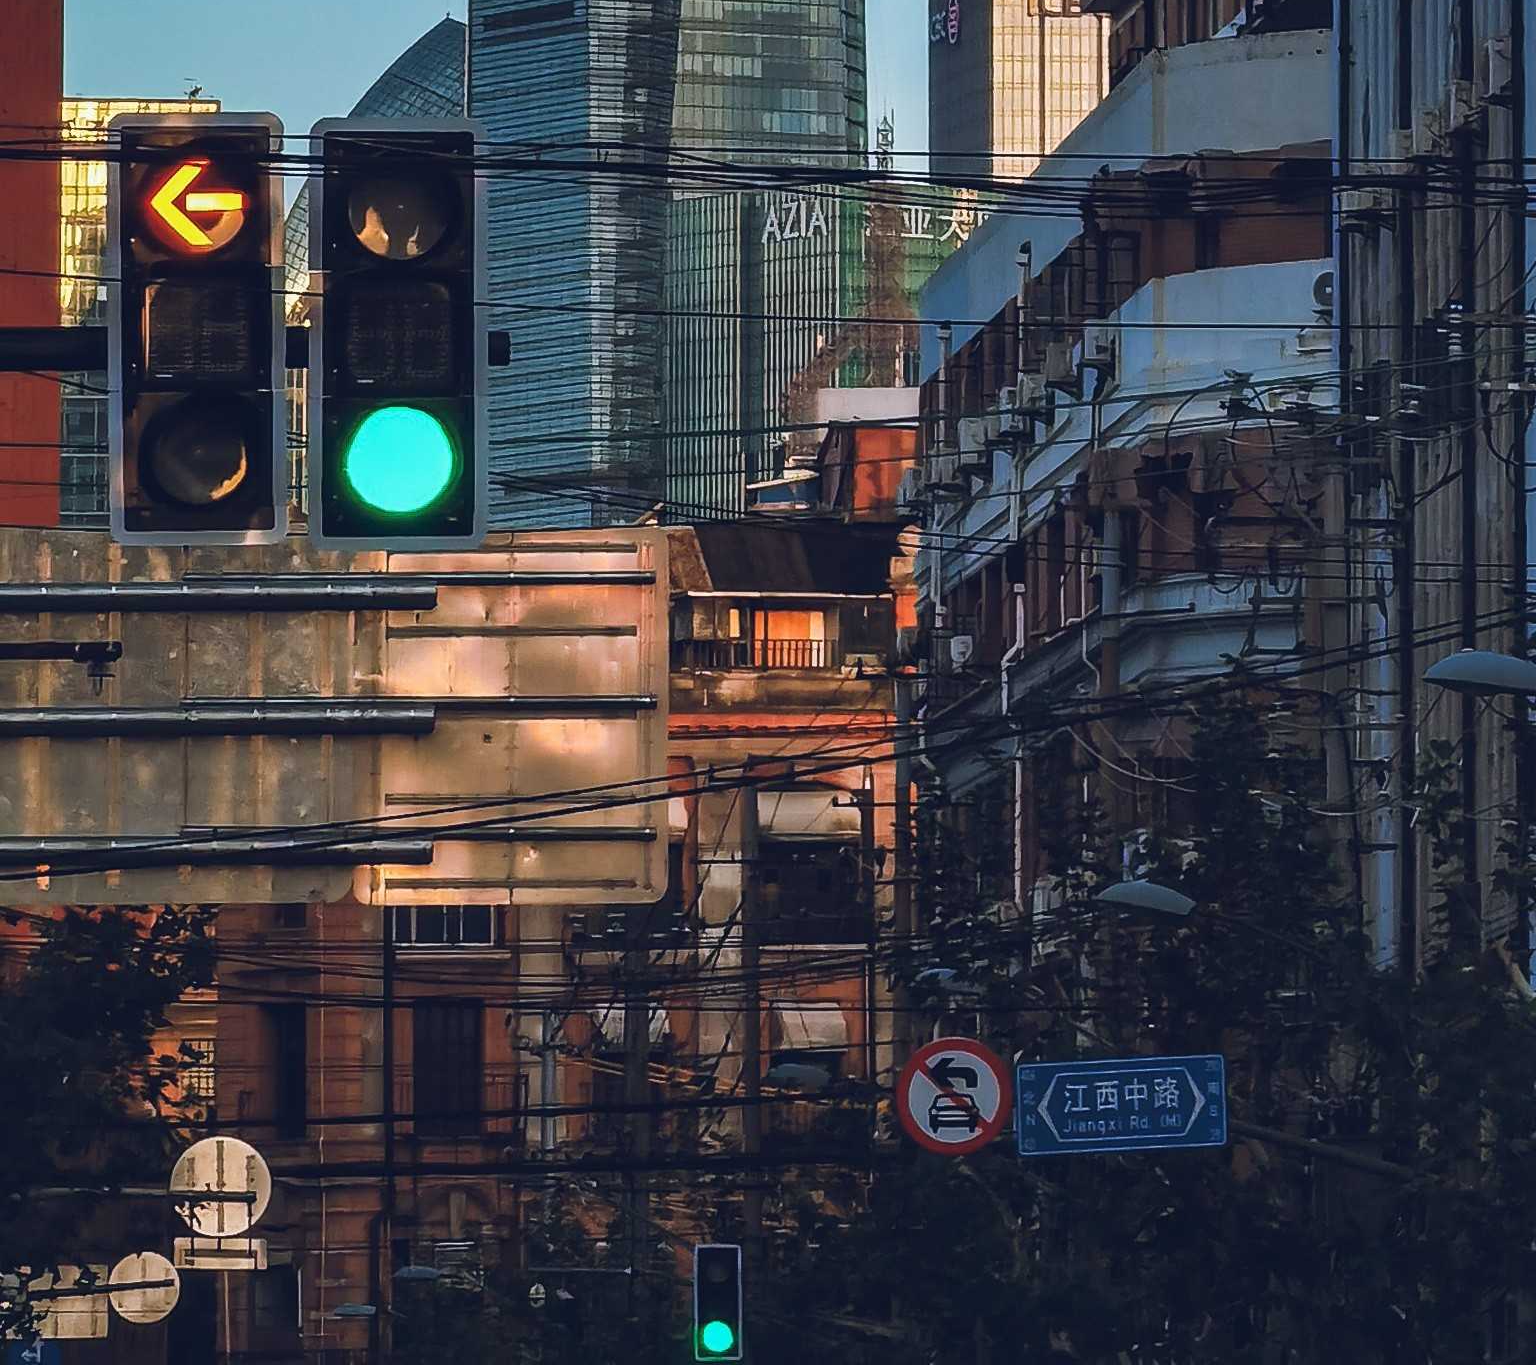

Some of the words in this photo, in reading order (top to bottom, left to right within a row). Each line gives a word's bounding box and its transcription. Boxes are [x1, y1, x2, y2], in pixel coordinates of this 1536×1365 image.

[761, 200, 828, 244] AZIA
[1063, 1076, 1180, 1113] 江西中路
[1063, 1117, 1122, 1135] Jiangxi
